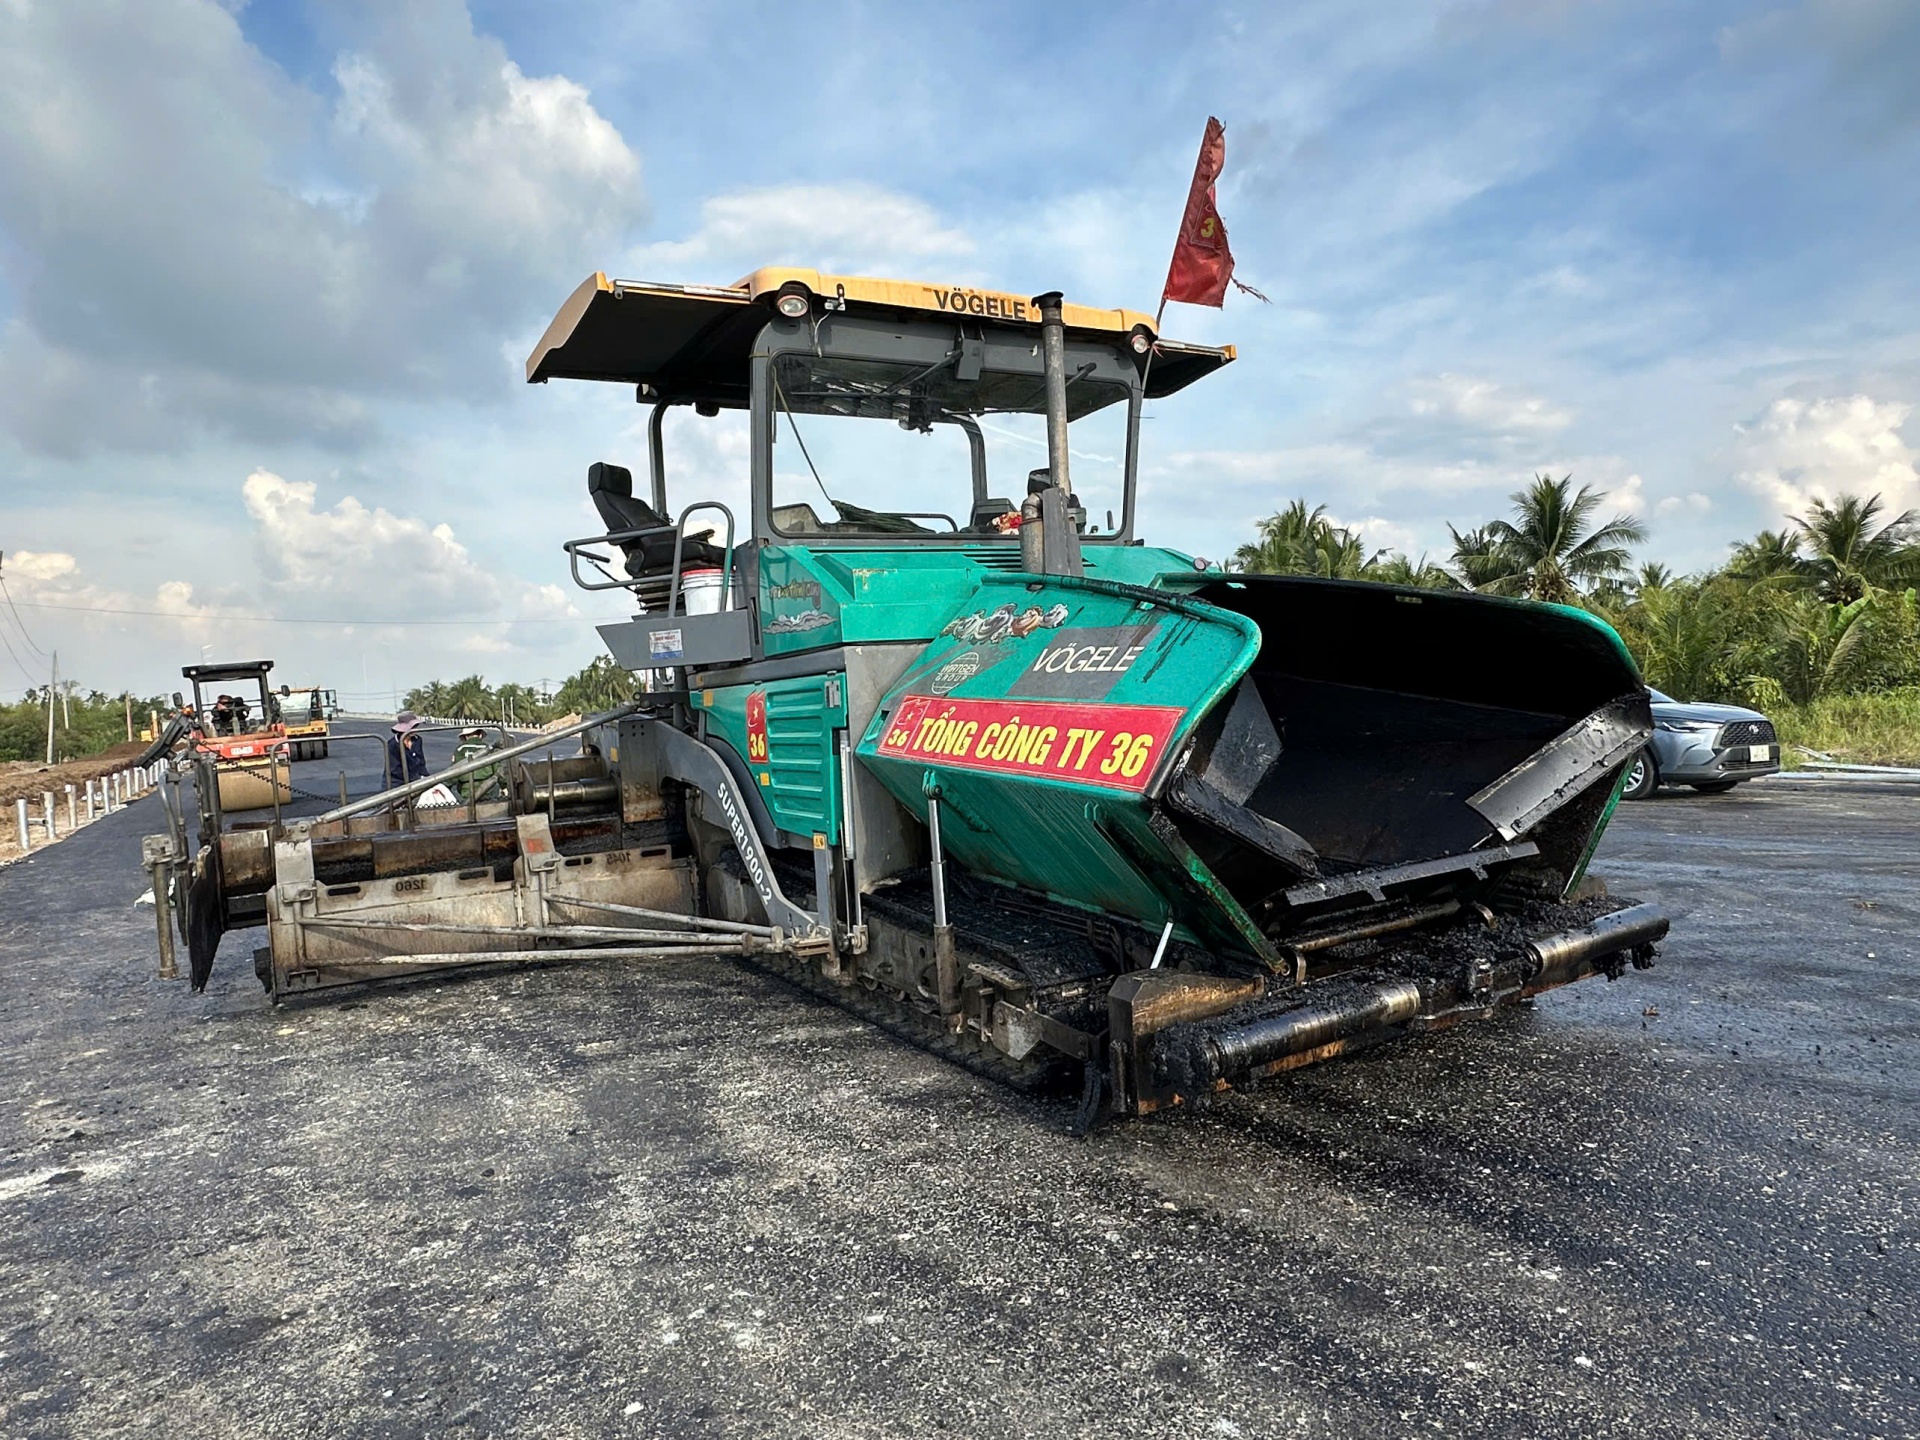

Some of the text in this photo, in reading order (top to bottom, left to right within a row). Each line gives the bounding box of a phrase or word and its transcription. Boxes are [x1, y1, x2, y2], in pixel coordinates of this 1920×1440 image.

[933, 288, 1026, 320] VÖGELE
[1032, 642, 1145, 674] VÖGELE
[750, 733, 765, 757] 36
[887, 728, 910, 747] 36
[912, 706, 1154, 778] TỔNG CÔNG TY 36
